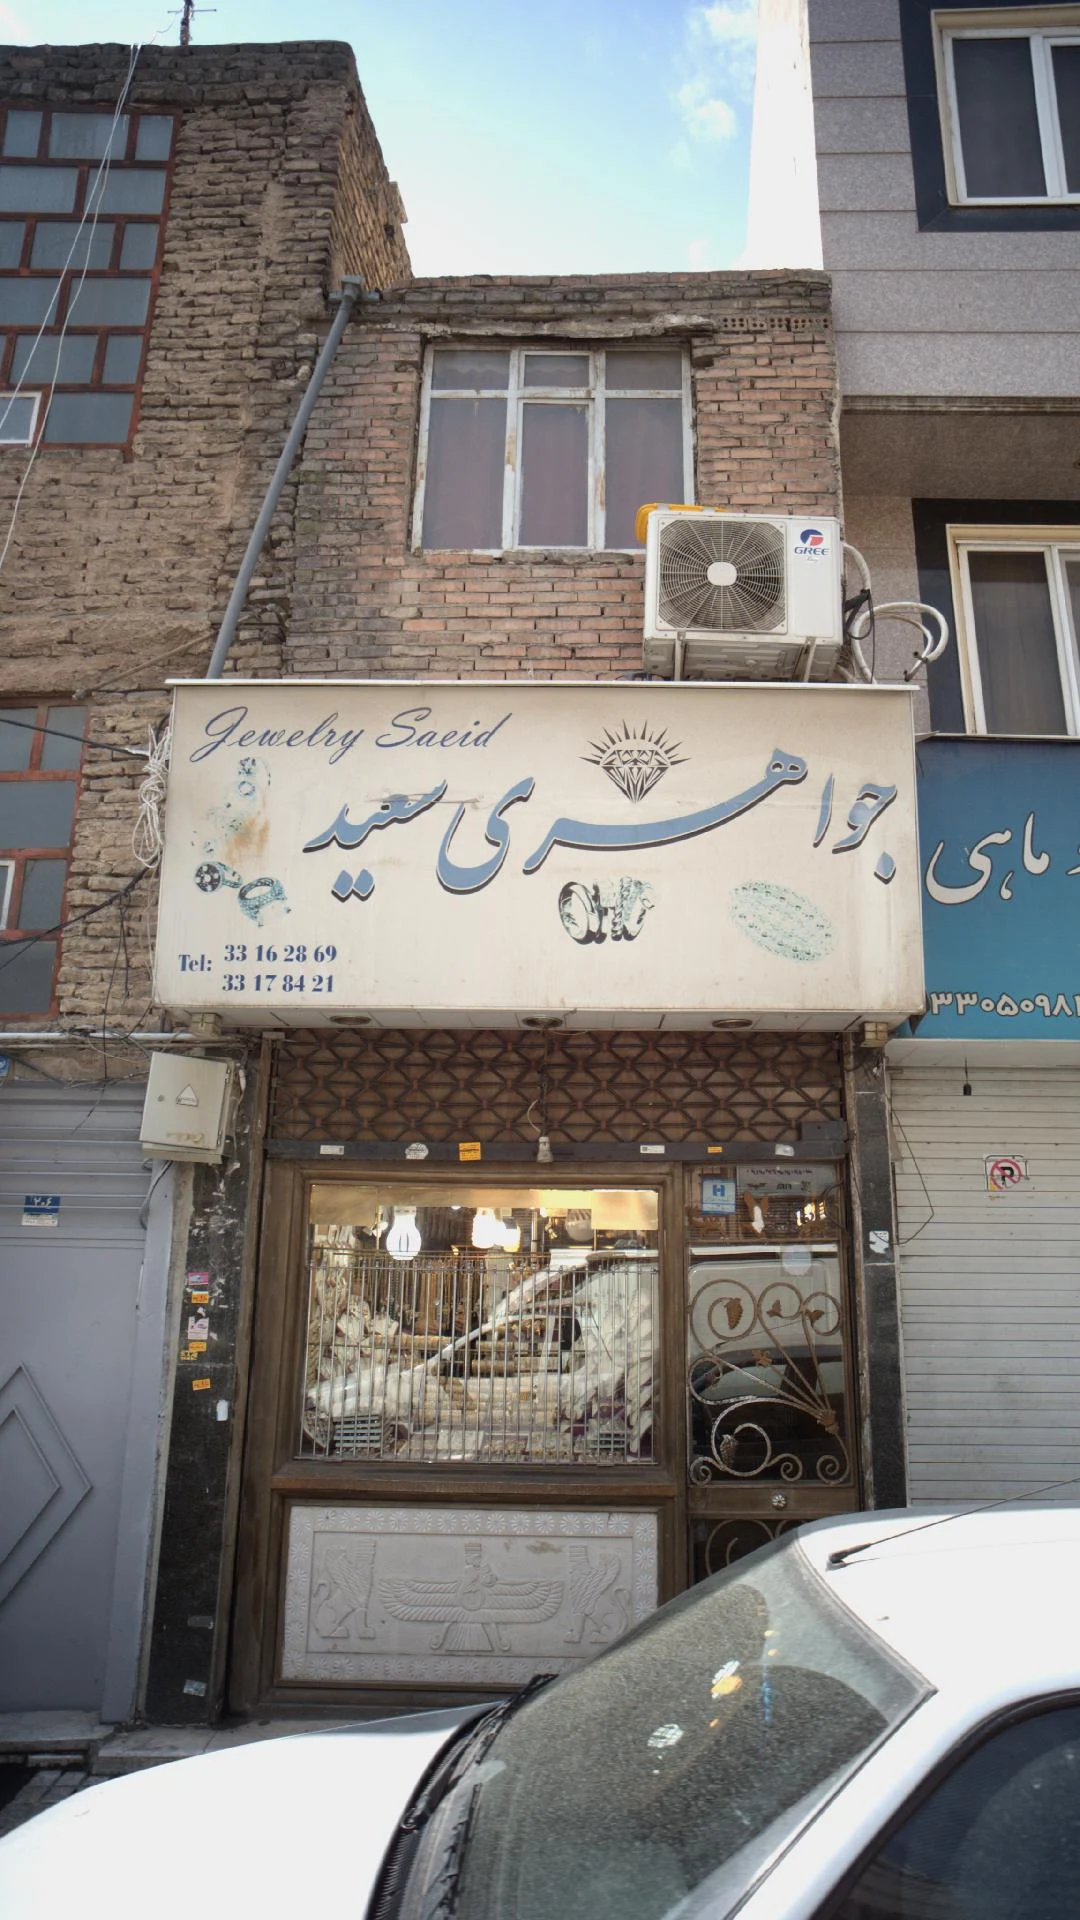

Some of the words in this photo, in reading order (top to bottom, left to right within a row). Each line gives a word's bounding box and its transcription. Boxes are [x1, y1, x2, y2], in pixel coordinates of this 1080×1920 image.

[794, 546, 831, 556] GREE
[189, 706, 365, 765] Jewelry
[375, 706, 513, 749] Saeid
[302, 779, 449, 904] سعید
[437, 747, 898, 896] جواهری
[178, 954, 213, 972] Tel:
[224, 944, 248, 962] 33
[255, 944, 278, 962] 16
[283, 944, 307, 962] 28
[313, 944, 337, 962] 69
[222, 974, 246, 991] 33
[254, 974, 277, 992] 17
[281, 974, 306, 992] 84
[311, 975, 334, 992] 21
